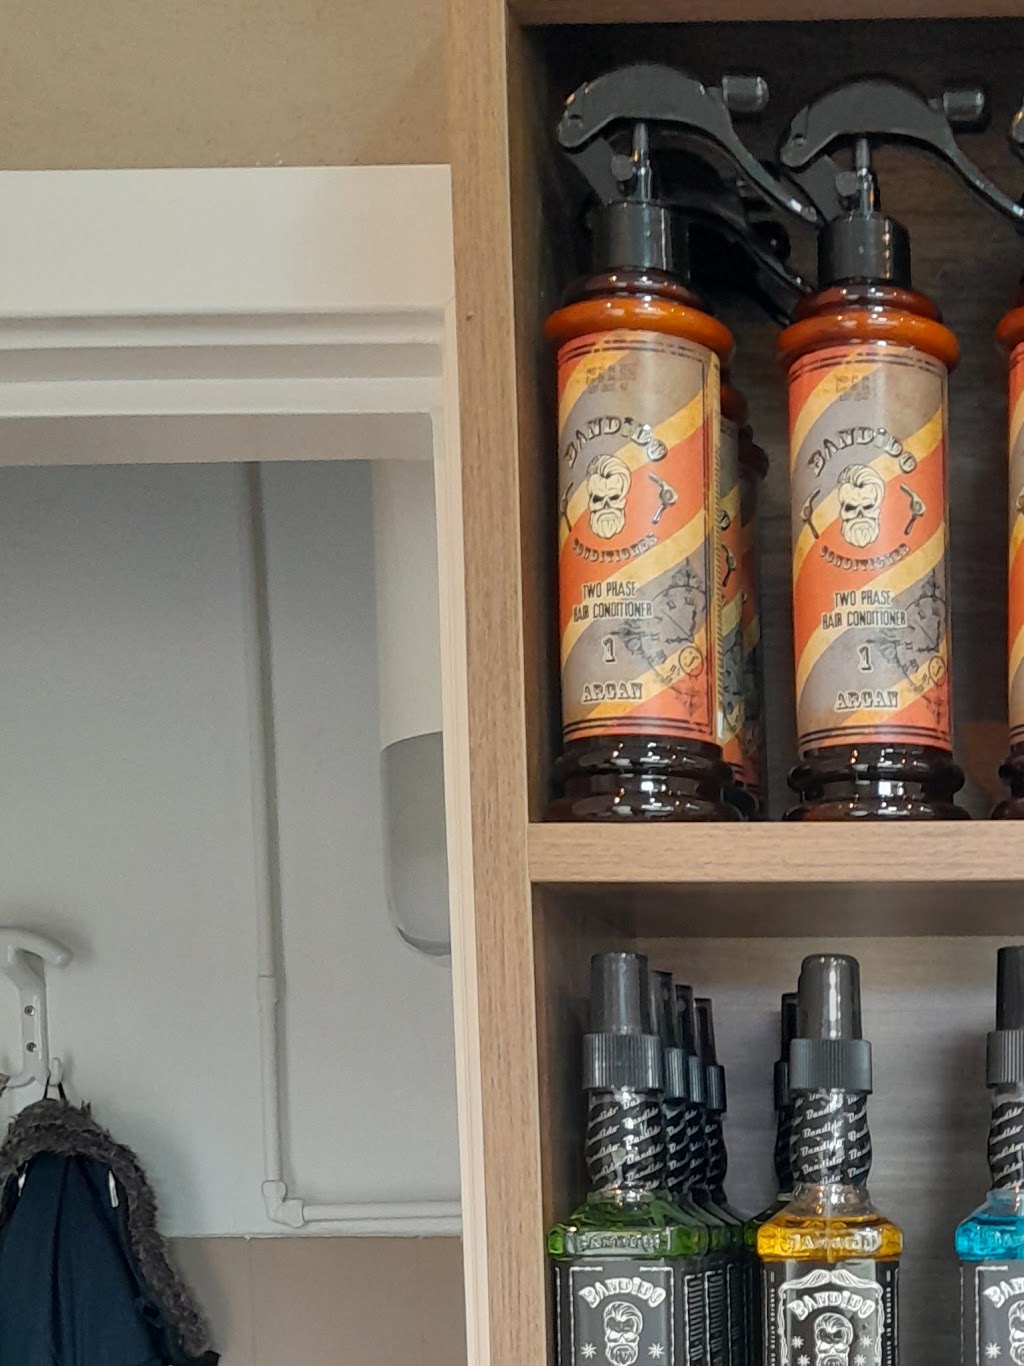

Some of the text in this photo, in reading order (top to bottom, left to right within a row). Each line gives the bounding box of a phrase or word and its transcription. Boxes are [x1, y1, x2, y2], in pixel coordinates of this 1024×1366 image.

[808, 427, 917, 477] BANDIDO
[583, 581, 637, 599] TWO PHASE
[834, 589, 892, 607] TWO PHASE
[847, 610, 906, 627] CONDITIONER
[603, 637, 616, 663] 1
[859, 646, 872, 671] 1
[583, 682, 643, 703] ARGAN
[836, 691, 898, 710] ARGAN
[578, 1277, 668, 1309] BANDIDO
[786, 1290, 875, 1320] BANDIDO
